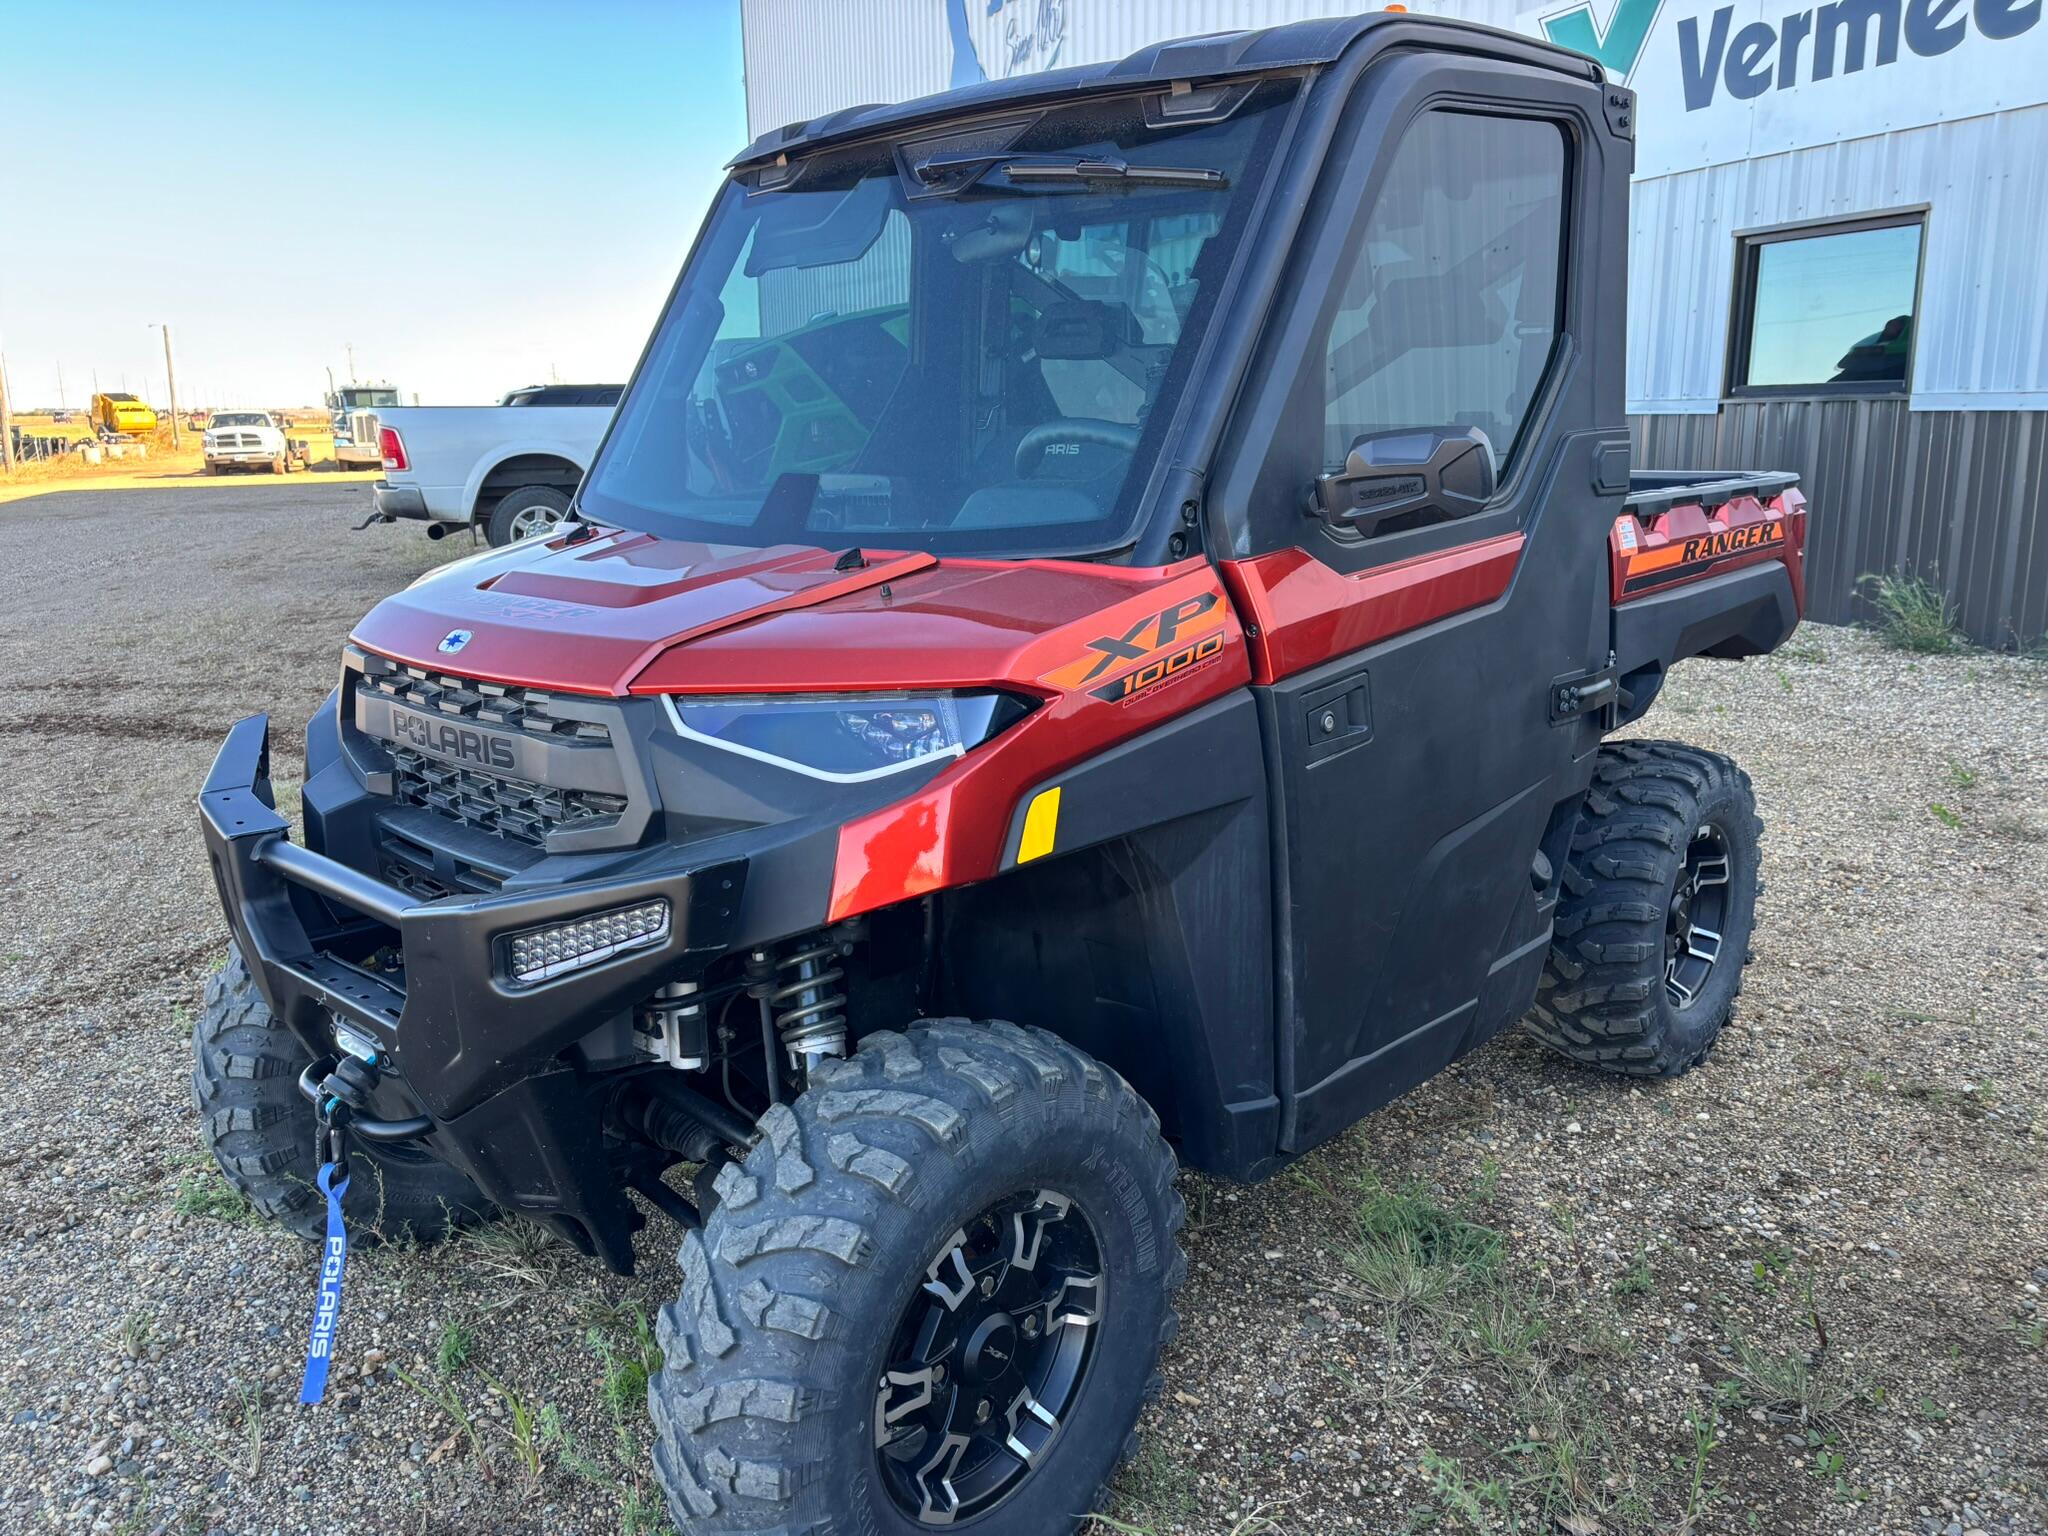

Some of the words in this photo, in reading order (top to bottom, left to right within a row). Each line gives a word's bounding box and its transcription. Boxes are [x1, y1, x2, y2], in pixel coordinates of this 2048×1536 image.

[1044, 444, 1081, 455] ARIS
[1680, 521, 1776, 564] RANGER
[1078, 591, 1219, 685] XP
[1122, 633, 1224, 696] 1000
[392, 709, 515, 769] POLARIS
[312, 1236, 344, 1358] POLARIS
